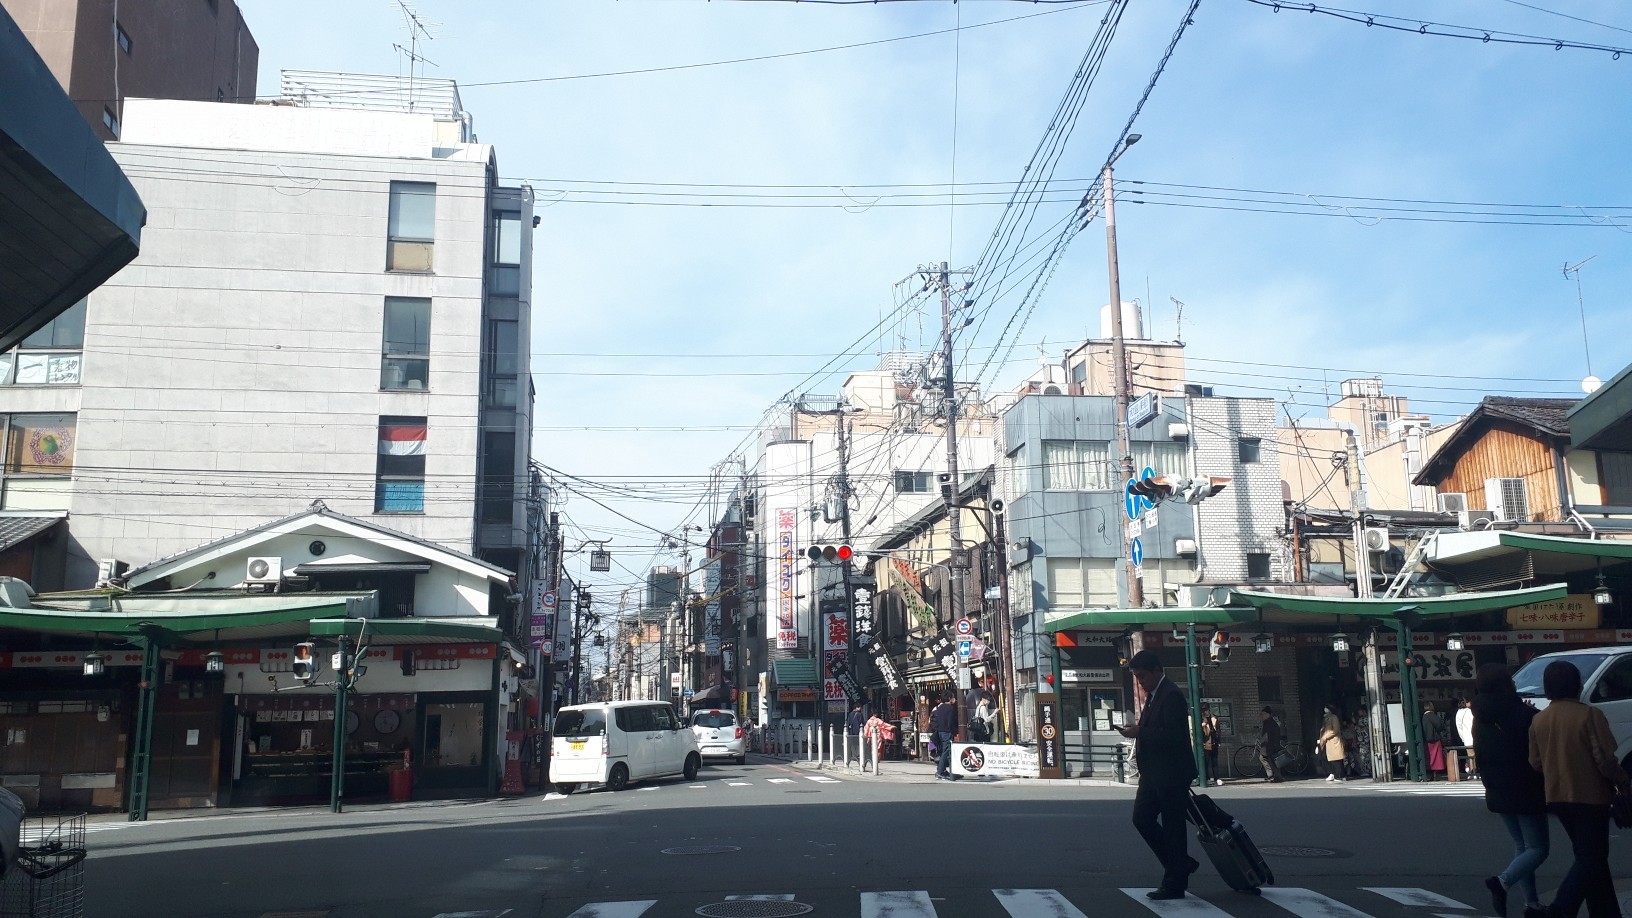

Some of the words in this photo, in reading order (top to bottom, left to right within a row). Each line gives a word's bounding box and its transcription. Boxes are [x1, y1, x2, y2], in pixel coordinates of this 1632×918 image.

[778, 511, 794, 530] 薬
[781, 535, 793, 592] ダイコク
[778, 631, 797, 641] 免税
[829, 613, 849, 647] 薬
[1044, 727, 1053, 737] 30
